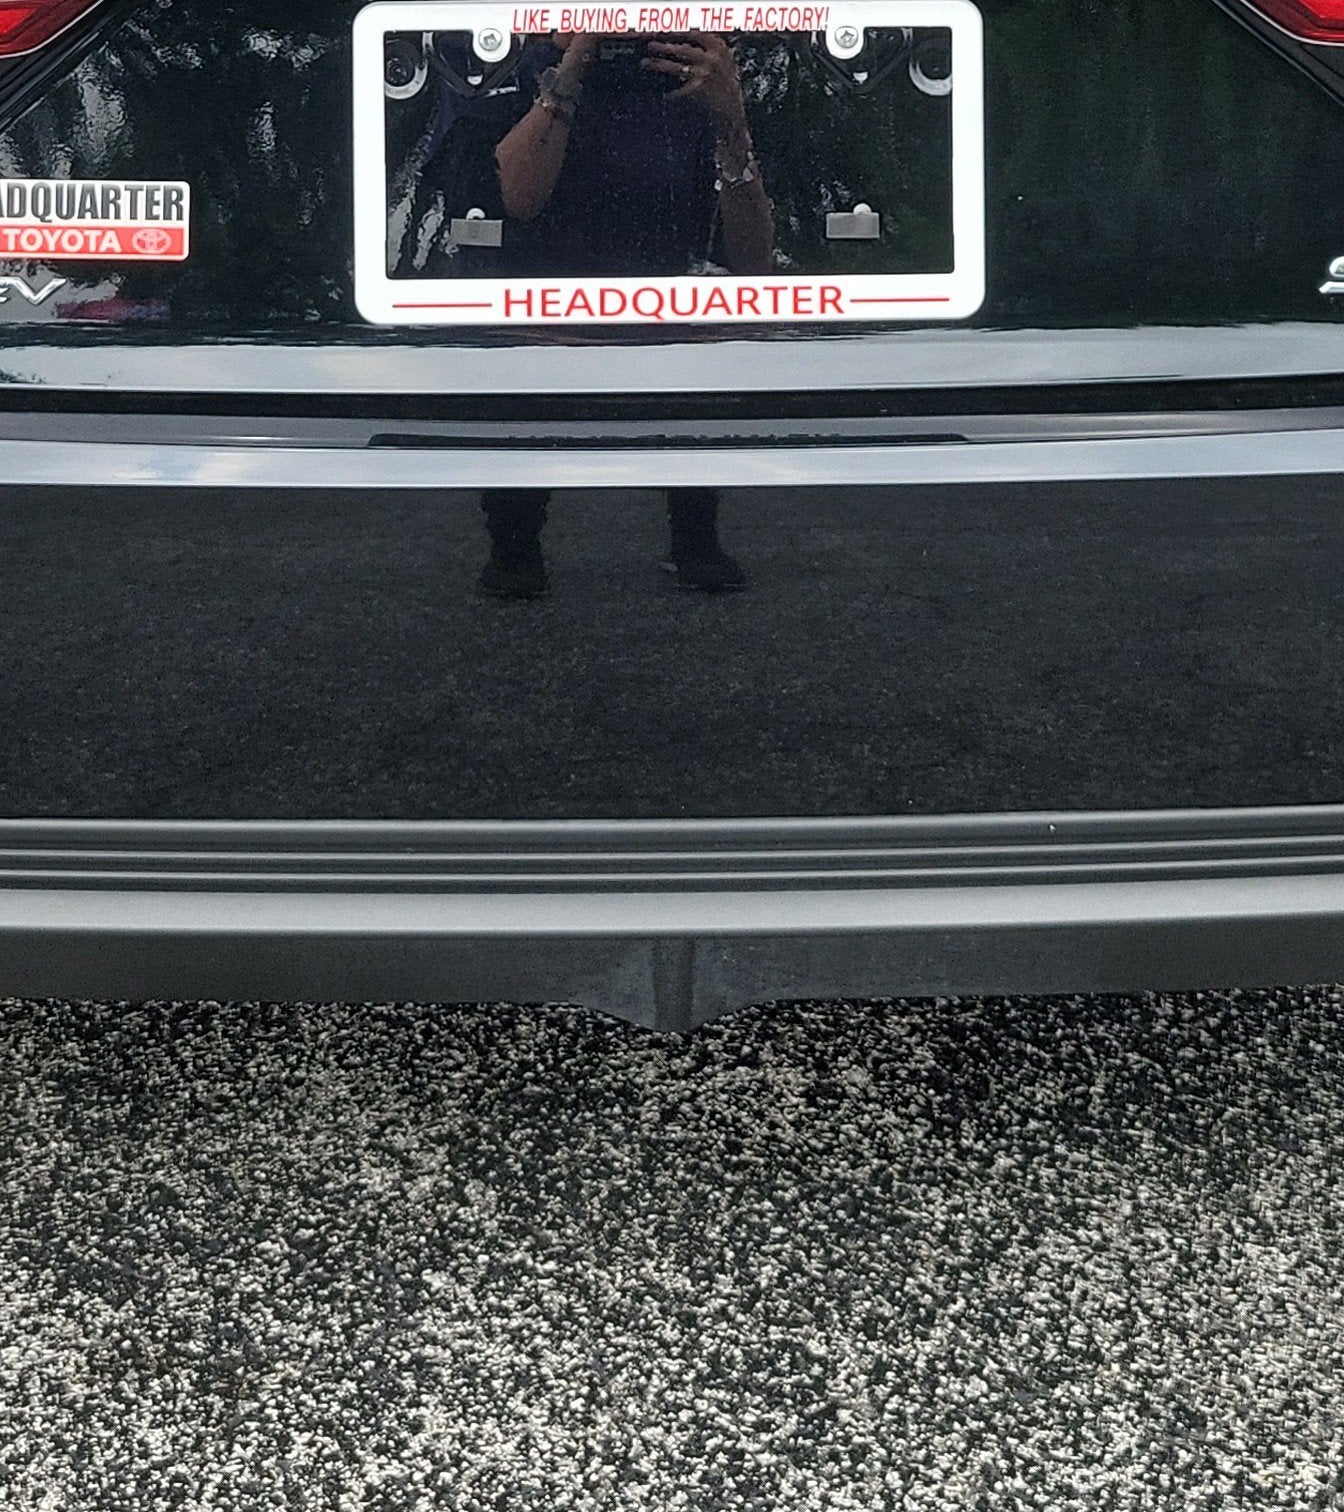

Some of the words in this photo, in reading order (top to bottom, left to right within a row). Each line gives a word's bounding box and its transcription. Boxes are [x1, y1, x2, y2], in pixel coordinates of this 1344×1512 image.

[512, 8, 551, 33] LIKE
[559, 7, 628, 33] BUYING
[638, 7, 690, 31] FROM
[701, 6, 734, 31] THE
[744, 6, 830, 31] FACTORY!
[2, 228, 123, 253] TOYOTA
[503, 285, 846, 321] HEADQUARTER
